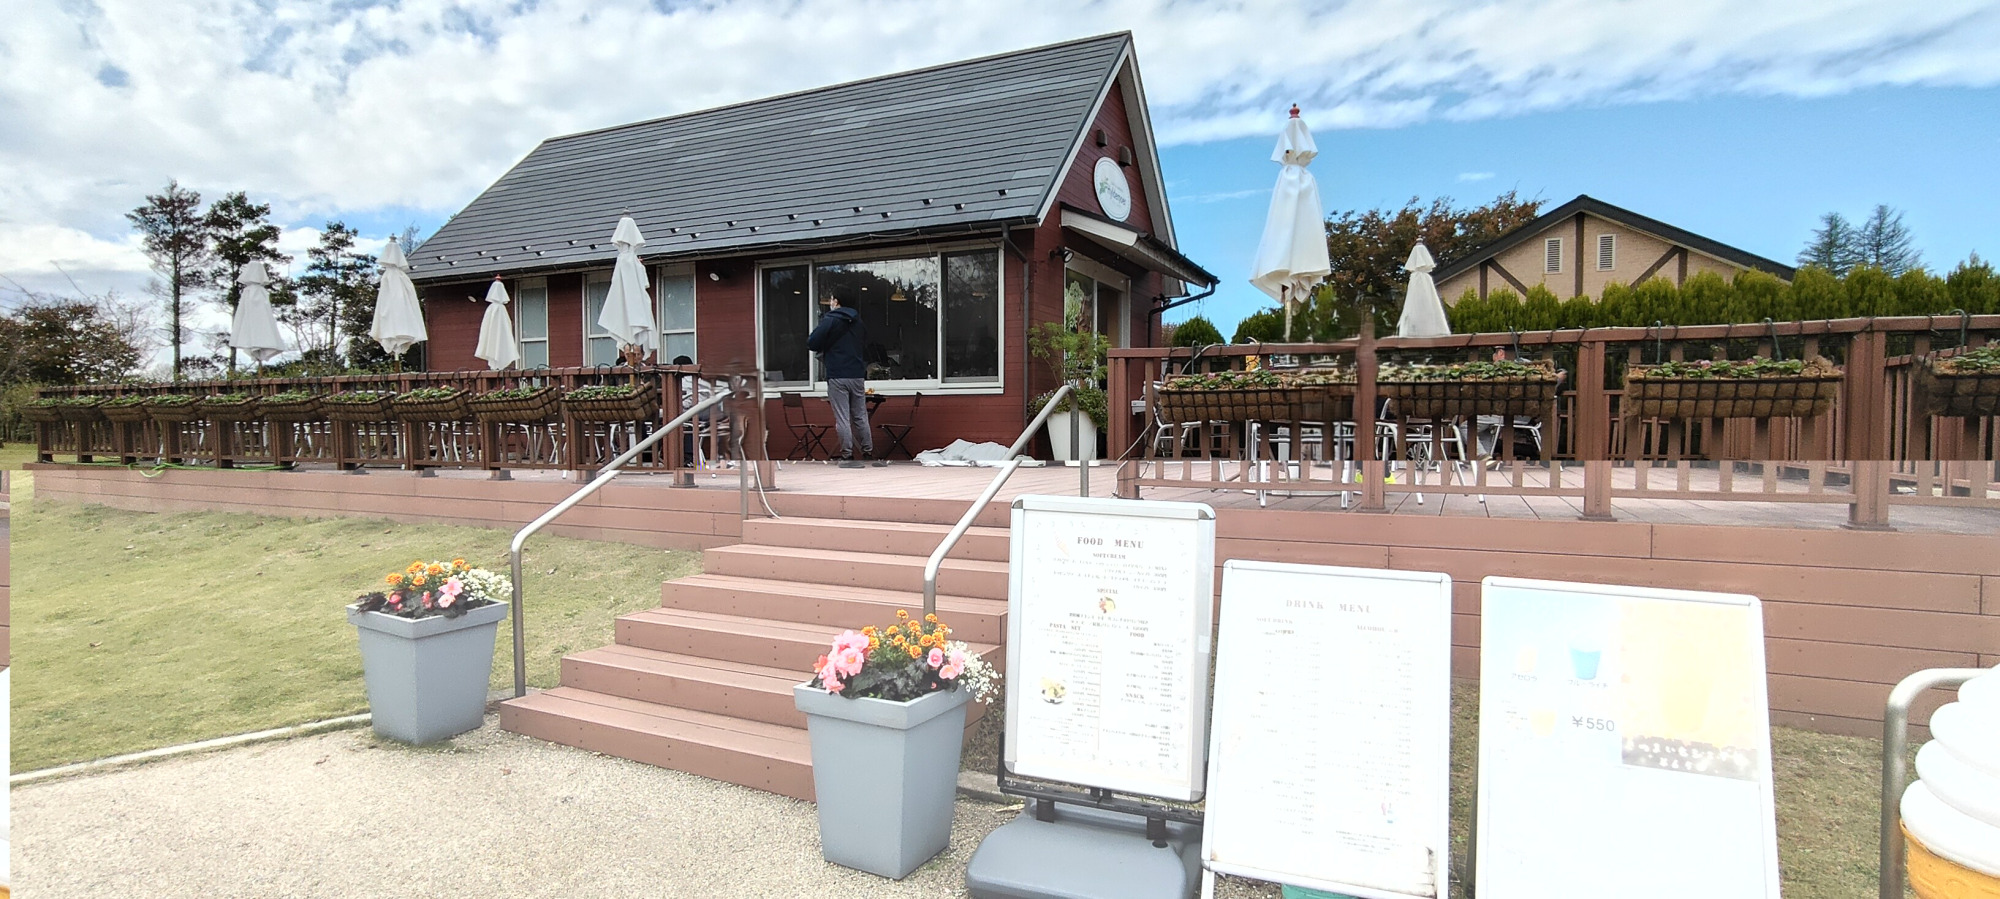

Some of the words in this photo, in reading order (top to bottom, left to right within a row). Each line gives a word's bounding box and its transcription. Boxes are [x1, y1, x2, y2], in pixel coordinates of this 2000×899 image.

[1077, 536, 1104, 546] FOOD
[1114, 539, 1144, 549] MENU
[1286, 599, 1324, 610] DRINK
[1338, 603, 1372, 614] MENU
[1571, 715, 1616, 732] ¥550
